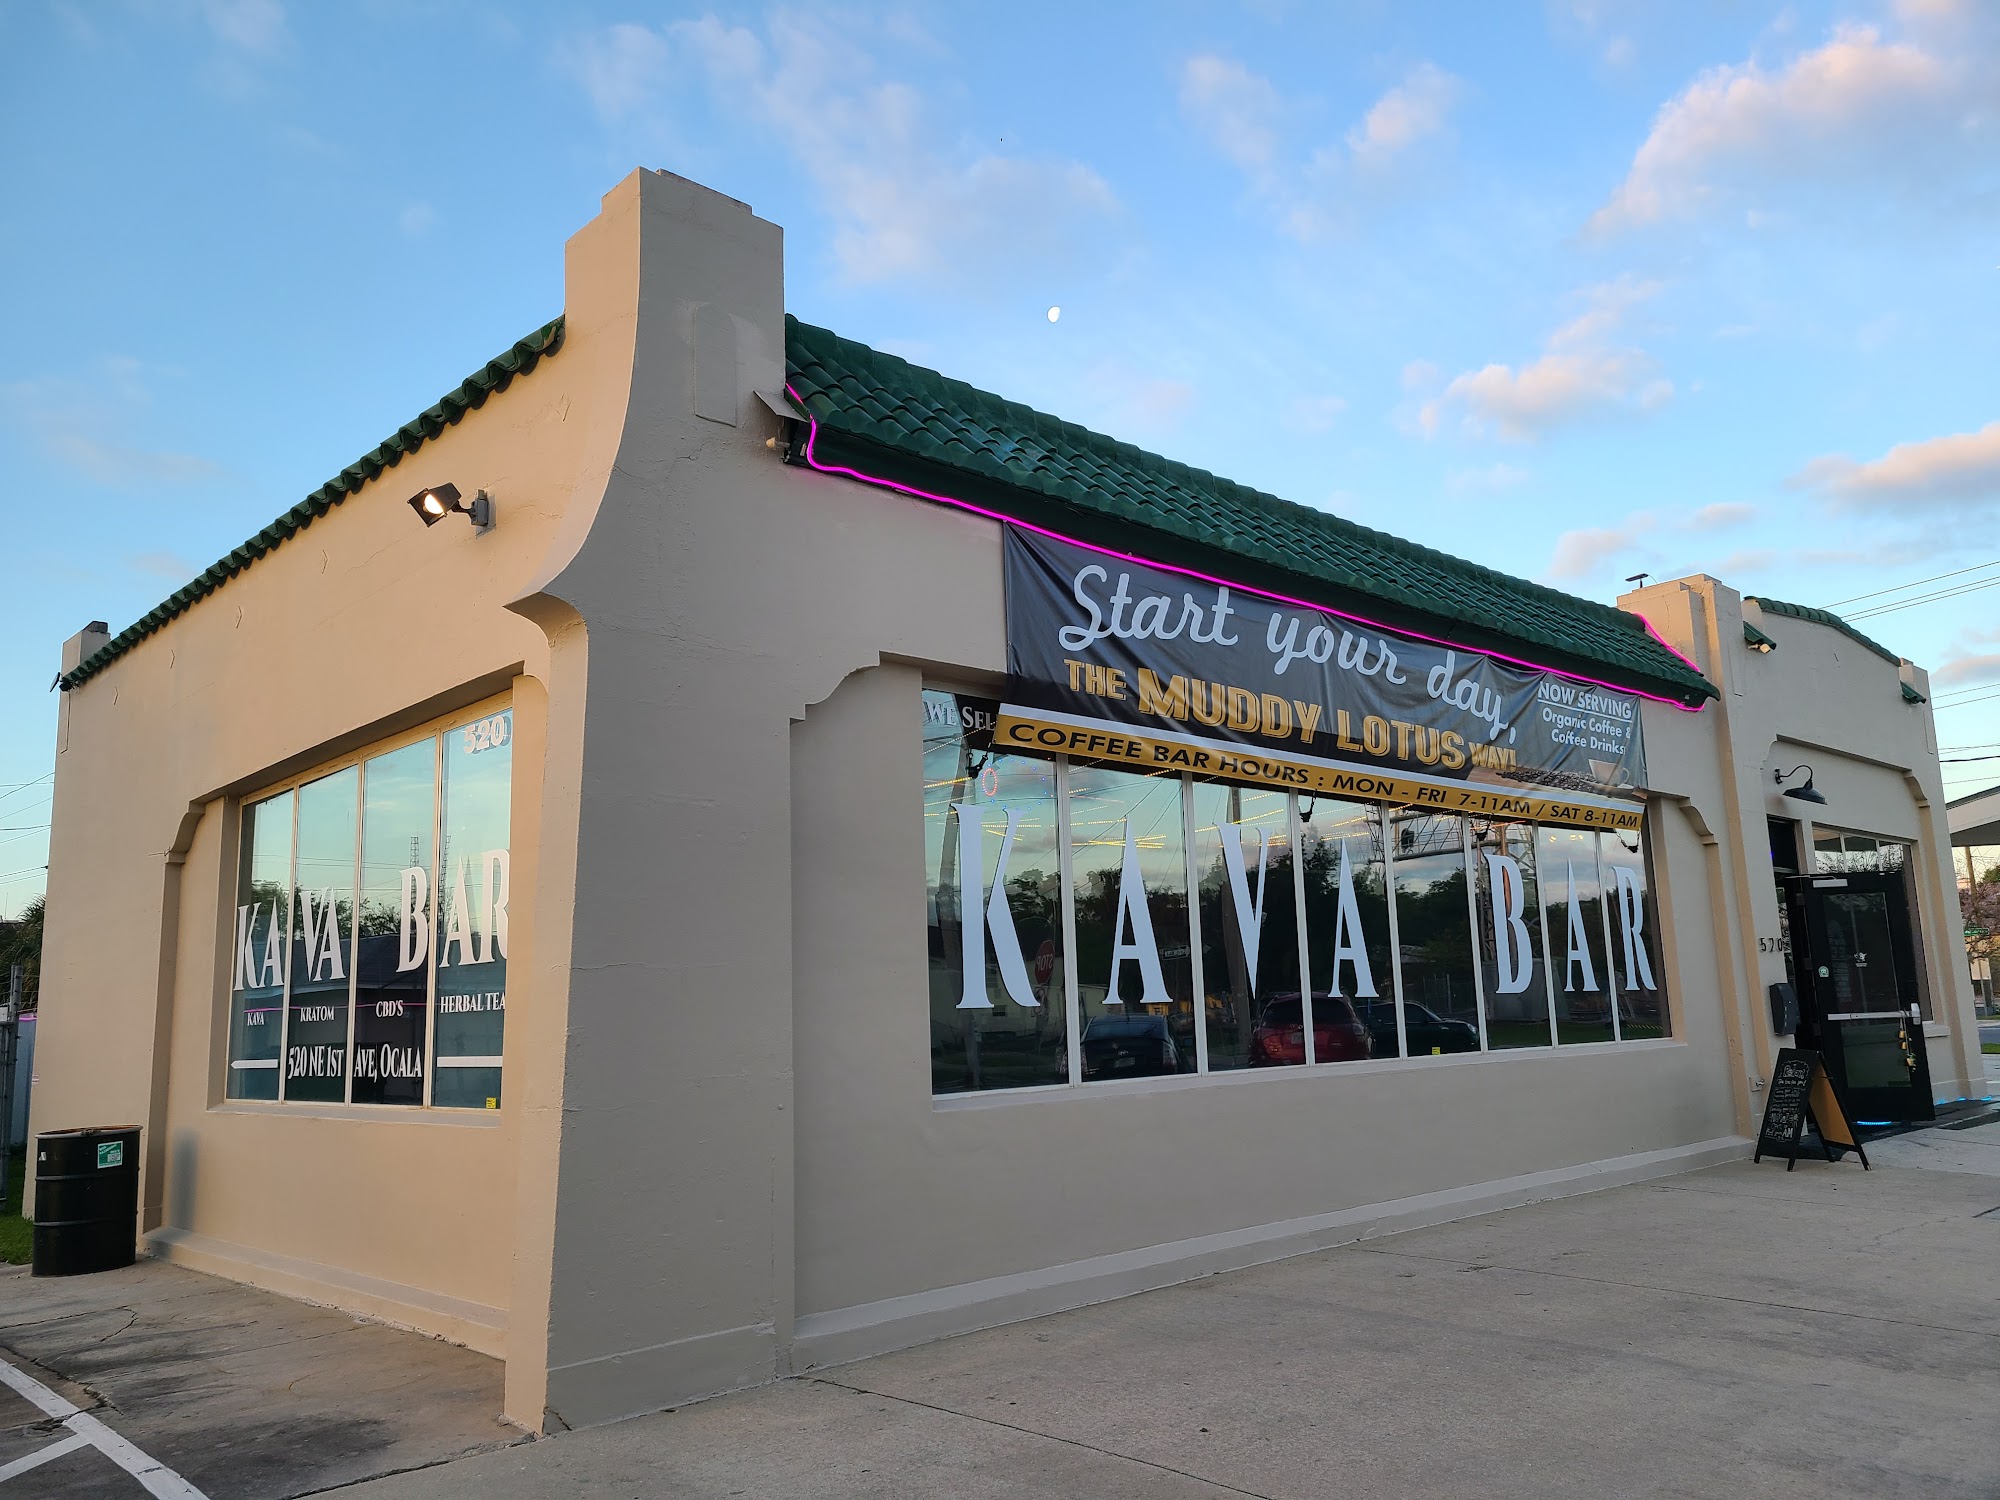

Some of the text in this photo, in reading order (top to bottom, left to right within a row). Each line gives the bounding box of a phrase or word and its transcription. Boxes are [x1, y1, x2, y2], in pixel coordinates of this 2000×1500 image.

[1058, 564, 1517, 745] Start your day,
[925, 700, 957, 726] WE
[1064, 658, 1128, 701] THE
[1137, 667, 1323, 745] MUDDY
[1336, 709, 1466, 771] LOTUS
[1538, 682, 1632, 719] NOW SERVING
[463, 714, 505, 754] 520
[1542, 707, 1631, 739] Organic Coffee &
[1551, 728, 1587, 747] Coffee
[1009, 723, 1142, 759] COFFEE
[1153, 745, 1209, 769] BAR
[1219, 755, 1308, 784] HOURS
[1332, 774, 1395, 796] MON
[1416, 787, 1447, 804] FRI
[1459, 792, 1531, 815] 7-11AM
[1550, 804, 1580, 821] SAT
[1583, 809, 1638, 829] 8-11AM
[233, 848, 510, 991] KAVA BAR
[951, 804, 1659, 1008] KAVA BAR
[1759, 937, 1784, 953] 520
[247, 1011, 265, 1026] KAVA
[300, 1005, 335, 1022] KRATOM
[375, 999, 404, 1018] CBD'S
[440, 993, 484, 1014] HERBAL
[287, 1043, 423, 1083] 520 NE 1ST AVE, OCALA
